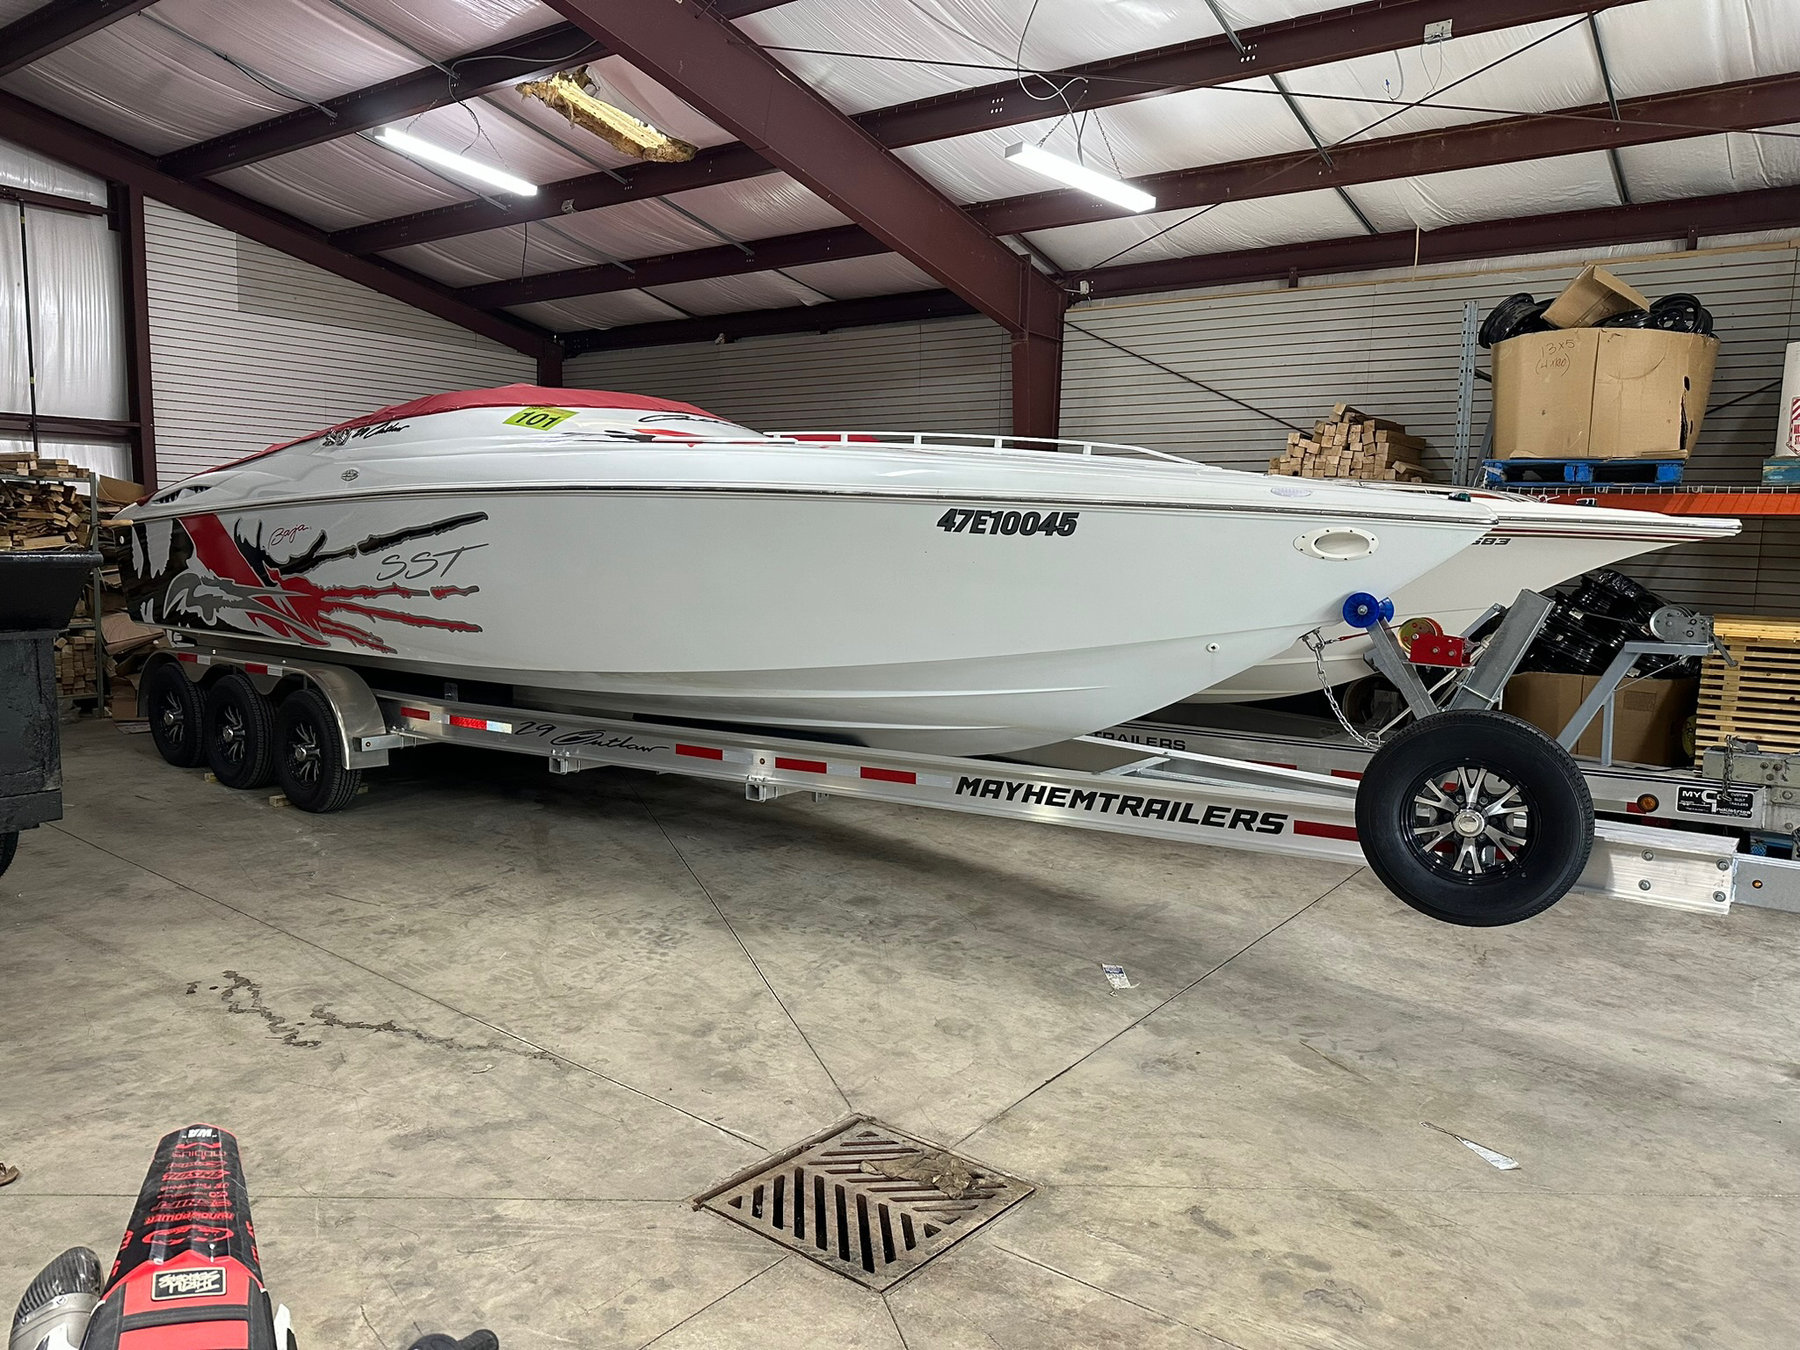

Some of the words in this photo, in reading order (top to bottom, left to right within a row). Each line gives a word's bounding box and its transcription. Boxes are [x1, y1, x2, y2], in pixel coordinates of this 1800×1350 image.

[515, 410, 562, 429] 101
[270, 523, 309, 546] Baja
[936, 508, 1081, 537] 47E10045
[376, 543, 490, 582] SST
[514, 721, 557, 737] 29
[550, 729, 670, 753] Outlaw
[955, 776, 1289, 835] MAYHEMTRAILERS
